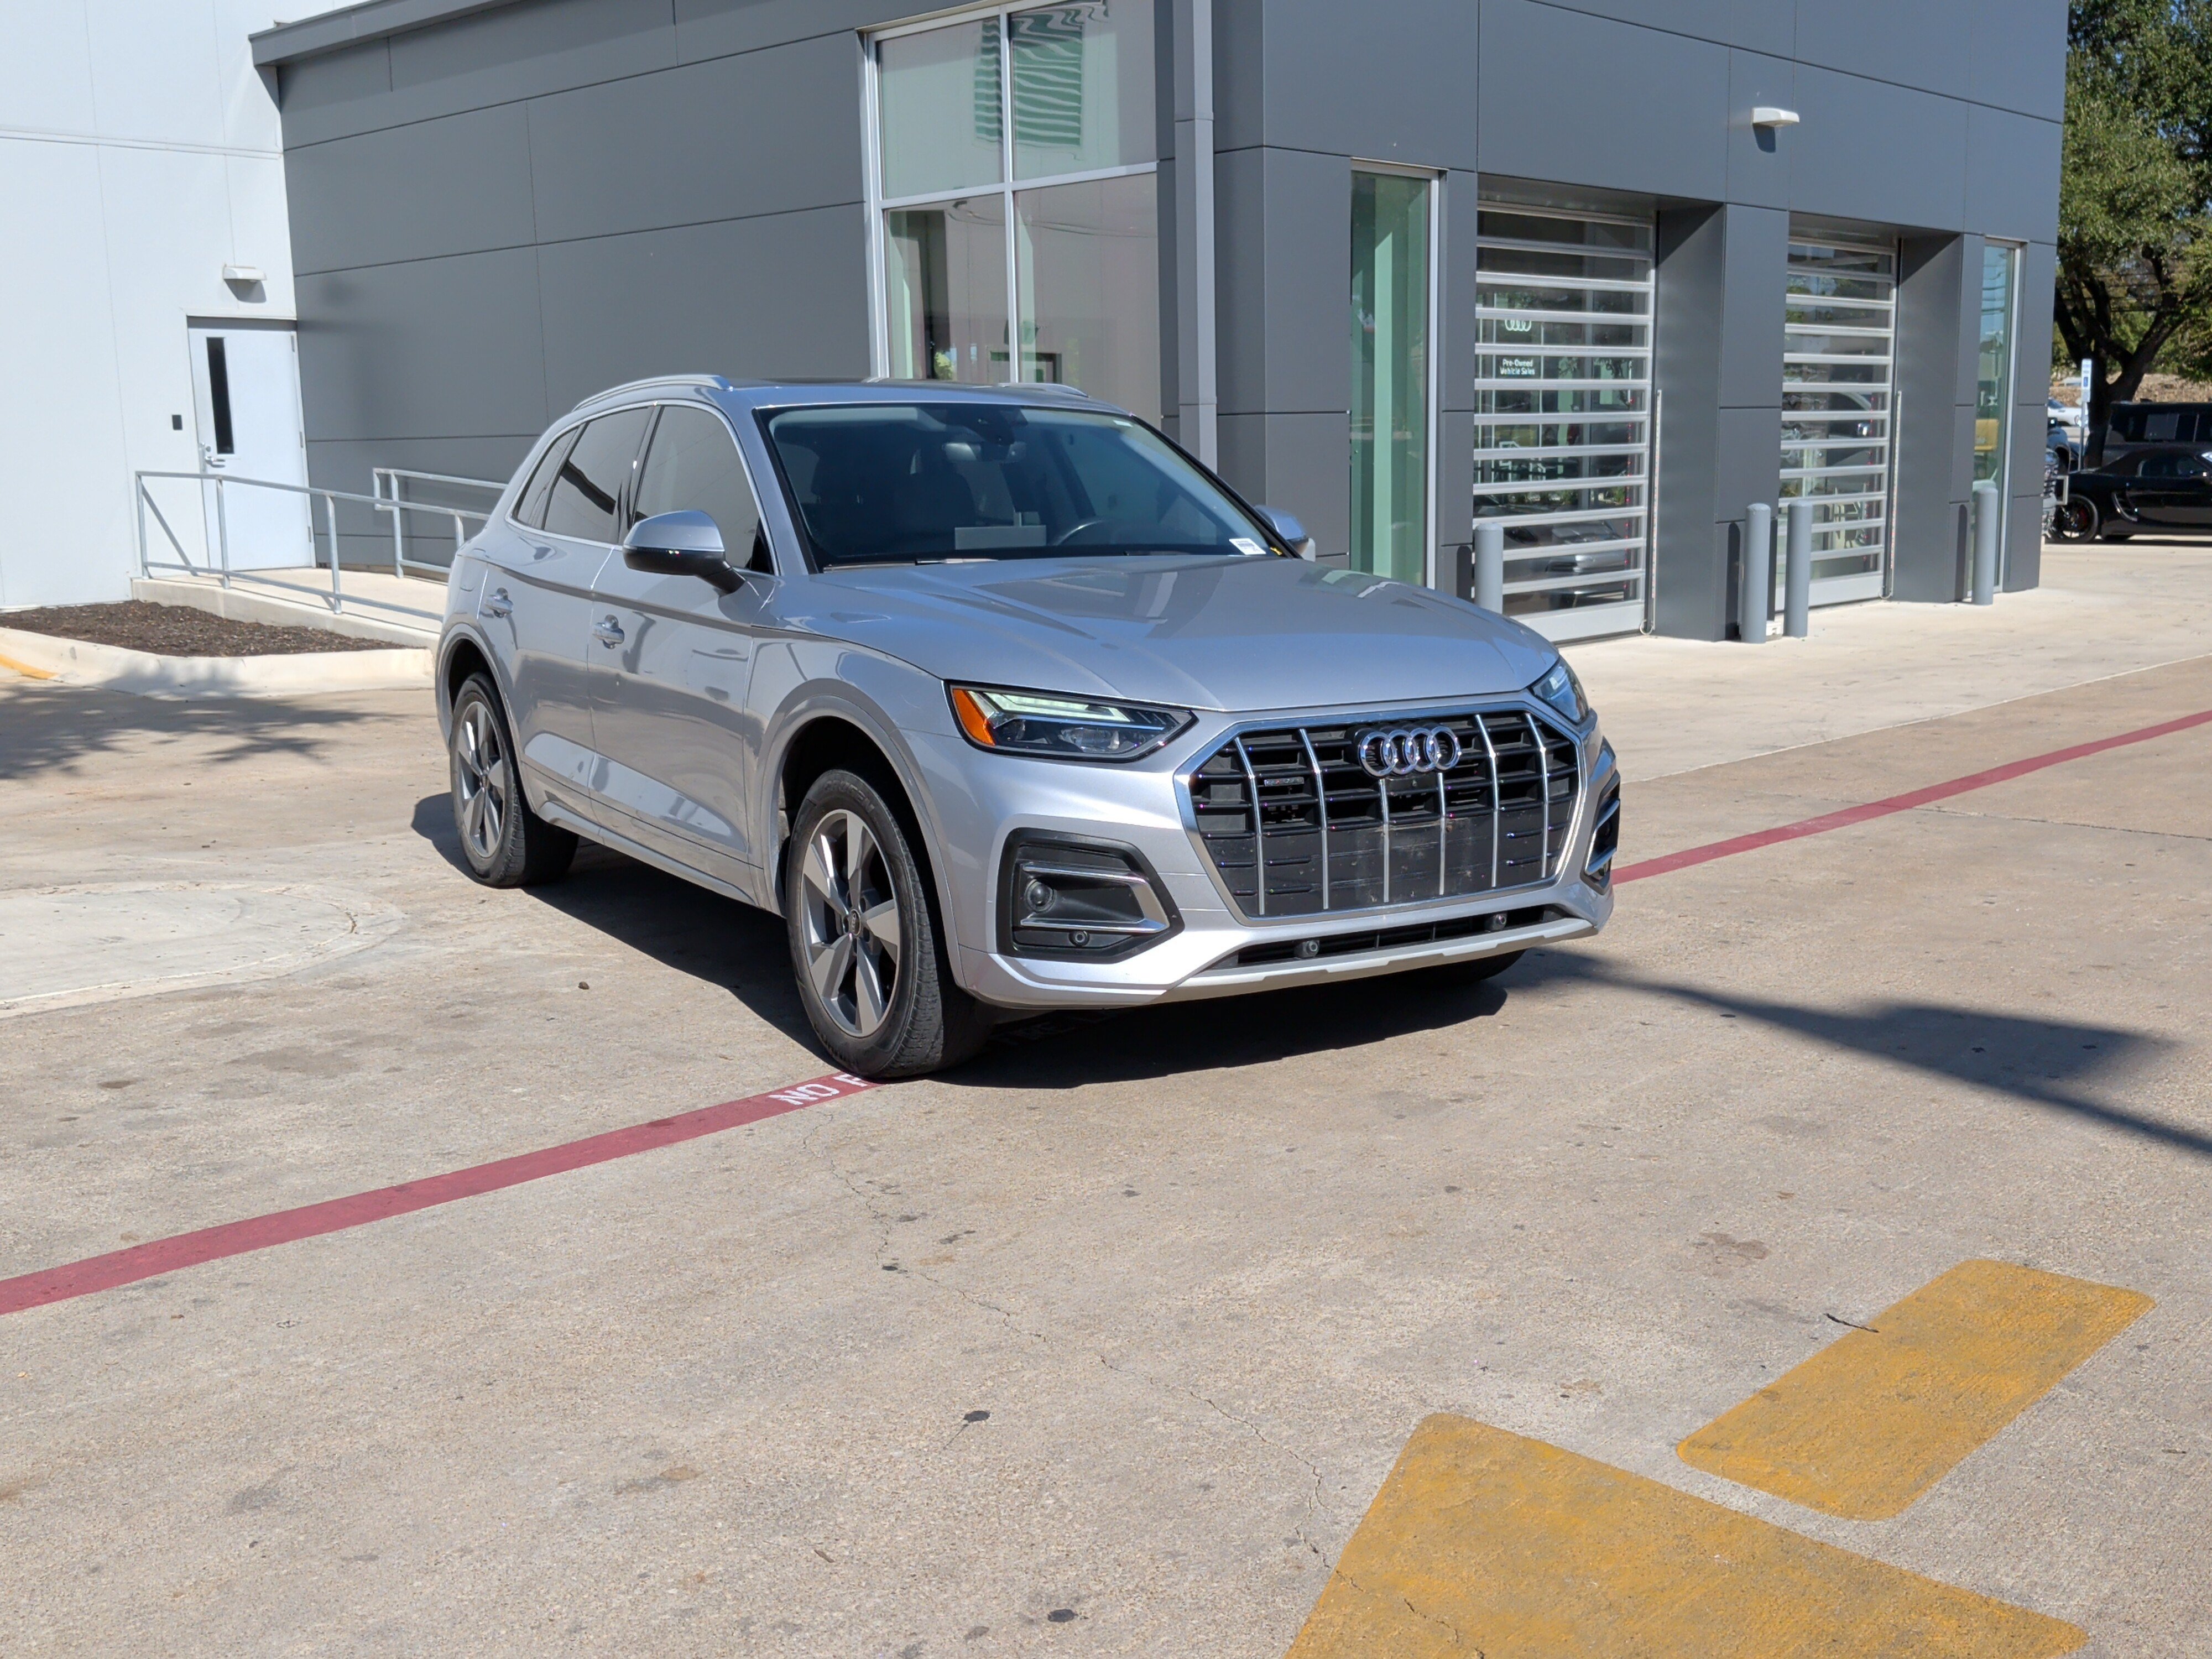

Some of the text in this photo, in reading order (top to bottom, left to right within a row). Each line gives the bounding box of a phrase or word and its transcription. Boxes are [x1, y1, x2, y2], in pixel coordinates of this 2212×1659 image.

[1502, 358, 1533, 367] Pre-Owned
[1500, 366, 1535, 375] Vehicle Sales
[768, 1083, 840, 1105] NO
